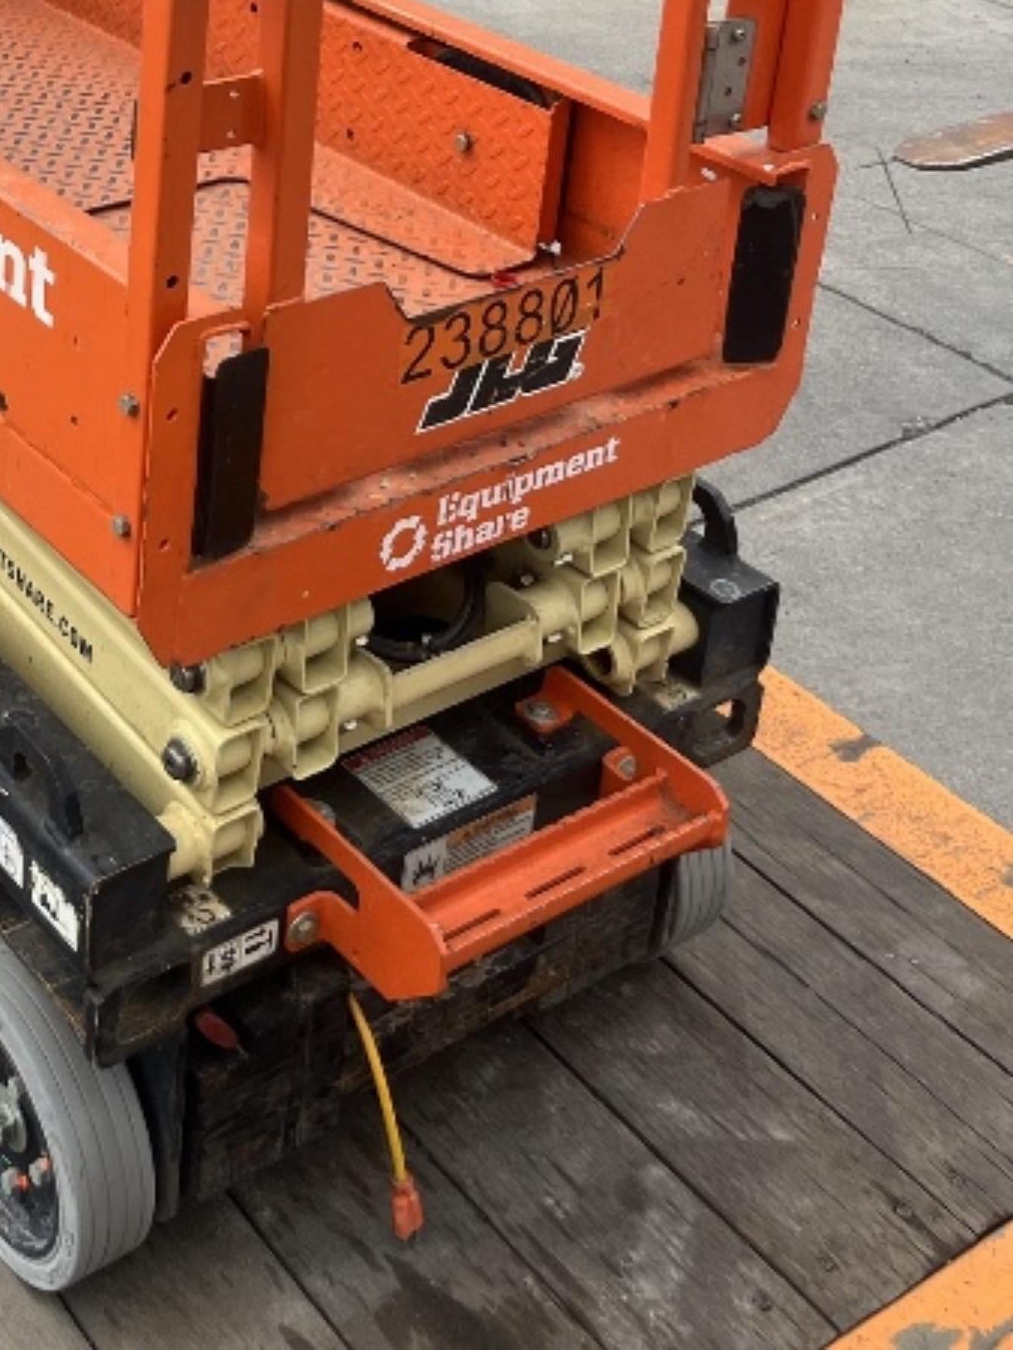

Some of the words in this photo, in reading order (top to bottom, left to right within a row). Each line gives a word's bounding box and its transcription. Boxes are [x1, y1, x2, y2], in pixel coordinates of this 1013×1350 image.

[401, 266, 606, 385] 238801
[437, 436, 621, 526] Equipment
[431, 506, 531, 562] Share
